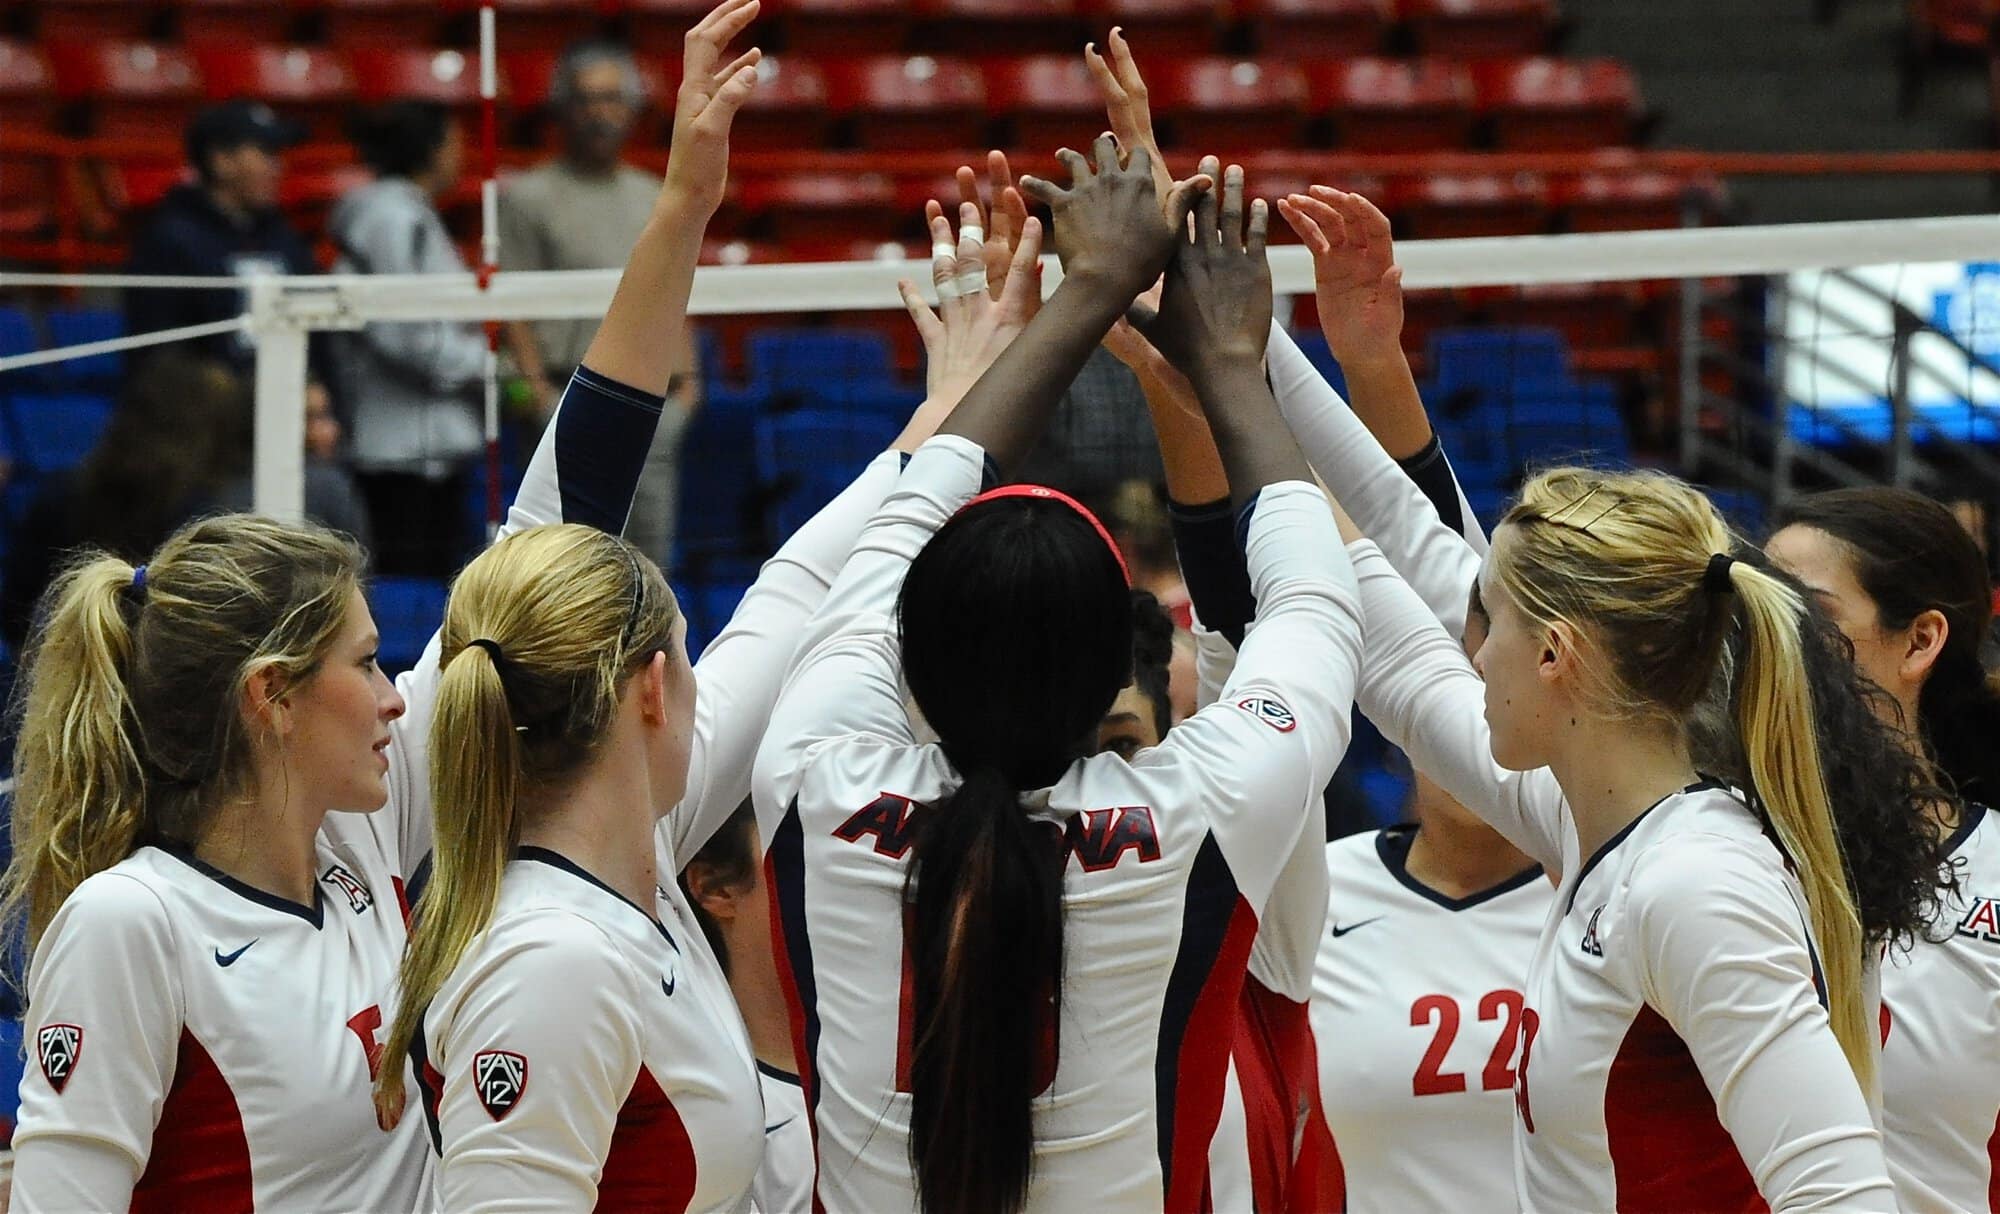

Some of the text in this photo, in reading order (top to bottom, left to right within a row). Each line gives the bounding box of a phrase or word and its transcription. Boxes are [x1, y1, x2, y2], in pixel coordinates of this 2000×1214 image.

[40, 1027, 79, 1065] PAC
[1410, 989, 1525, 1096] 22
[48, 1052, 67, 1078] 12
[476, 1053, 523, 1094] PAC
[486, 1080, 512, 1106] 12
